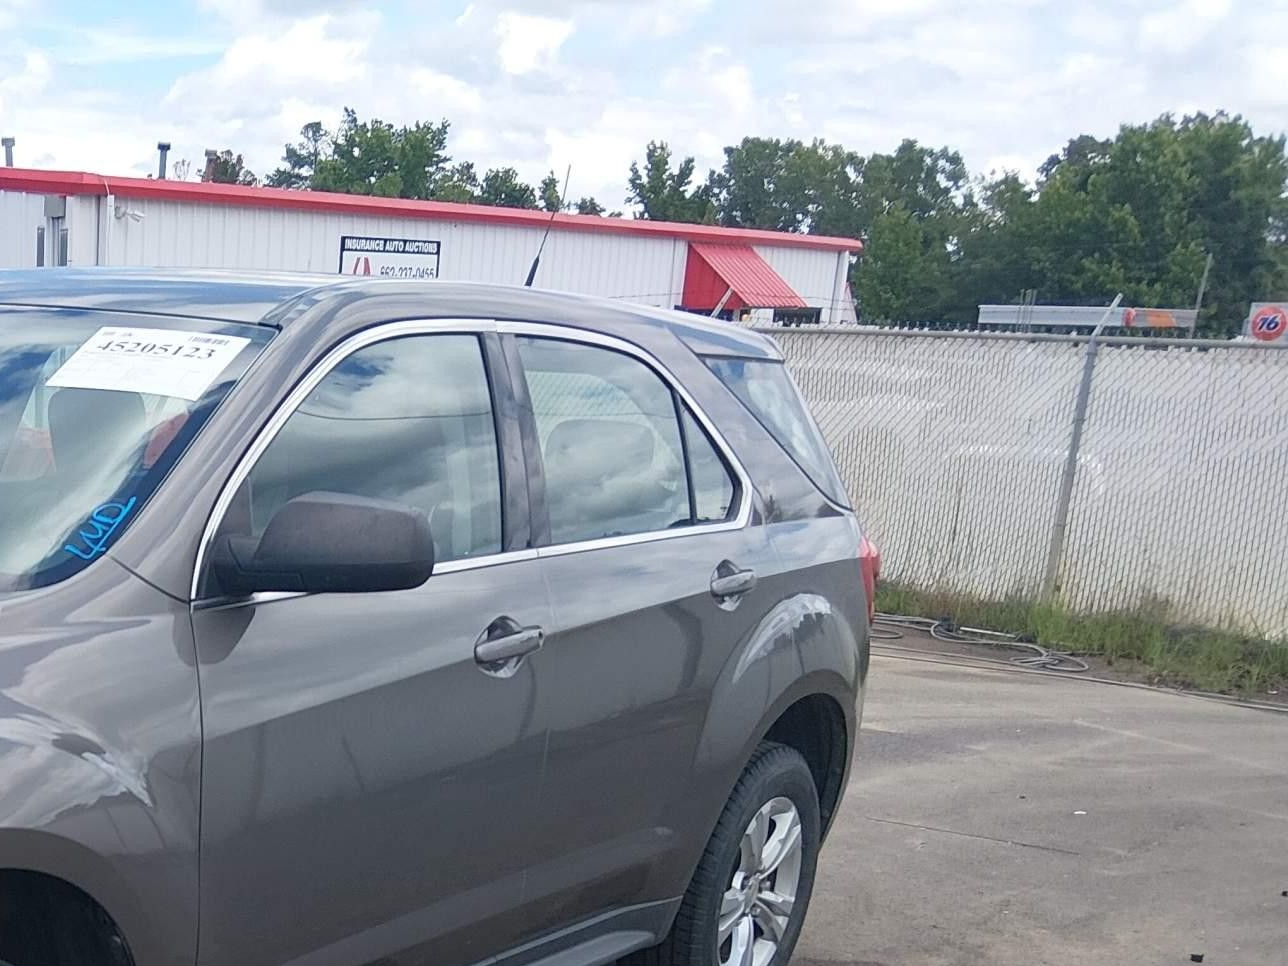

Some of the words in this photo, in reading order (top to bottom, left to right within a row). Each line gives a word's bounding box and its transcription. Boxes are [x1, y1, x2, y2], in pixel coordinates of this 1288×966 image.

[344, 238, 384, 251] INSURANCE
[385, 240, 404, 252] AUTO
[405, 241, 438, 254] AUCTIONS
[1257, 314, 1282, 331] 76
[97, 339, 216, 360] 45205123
